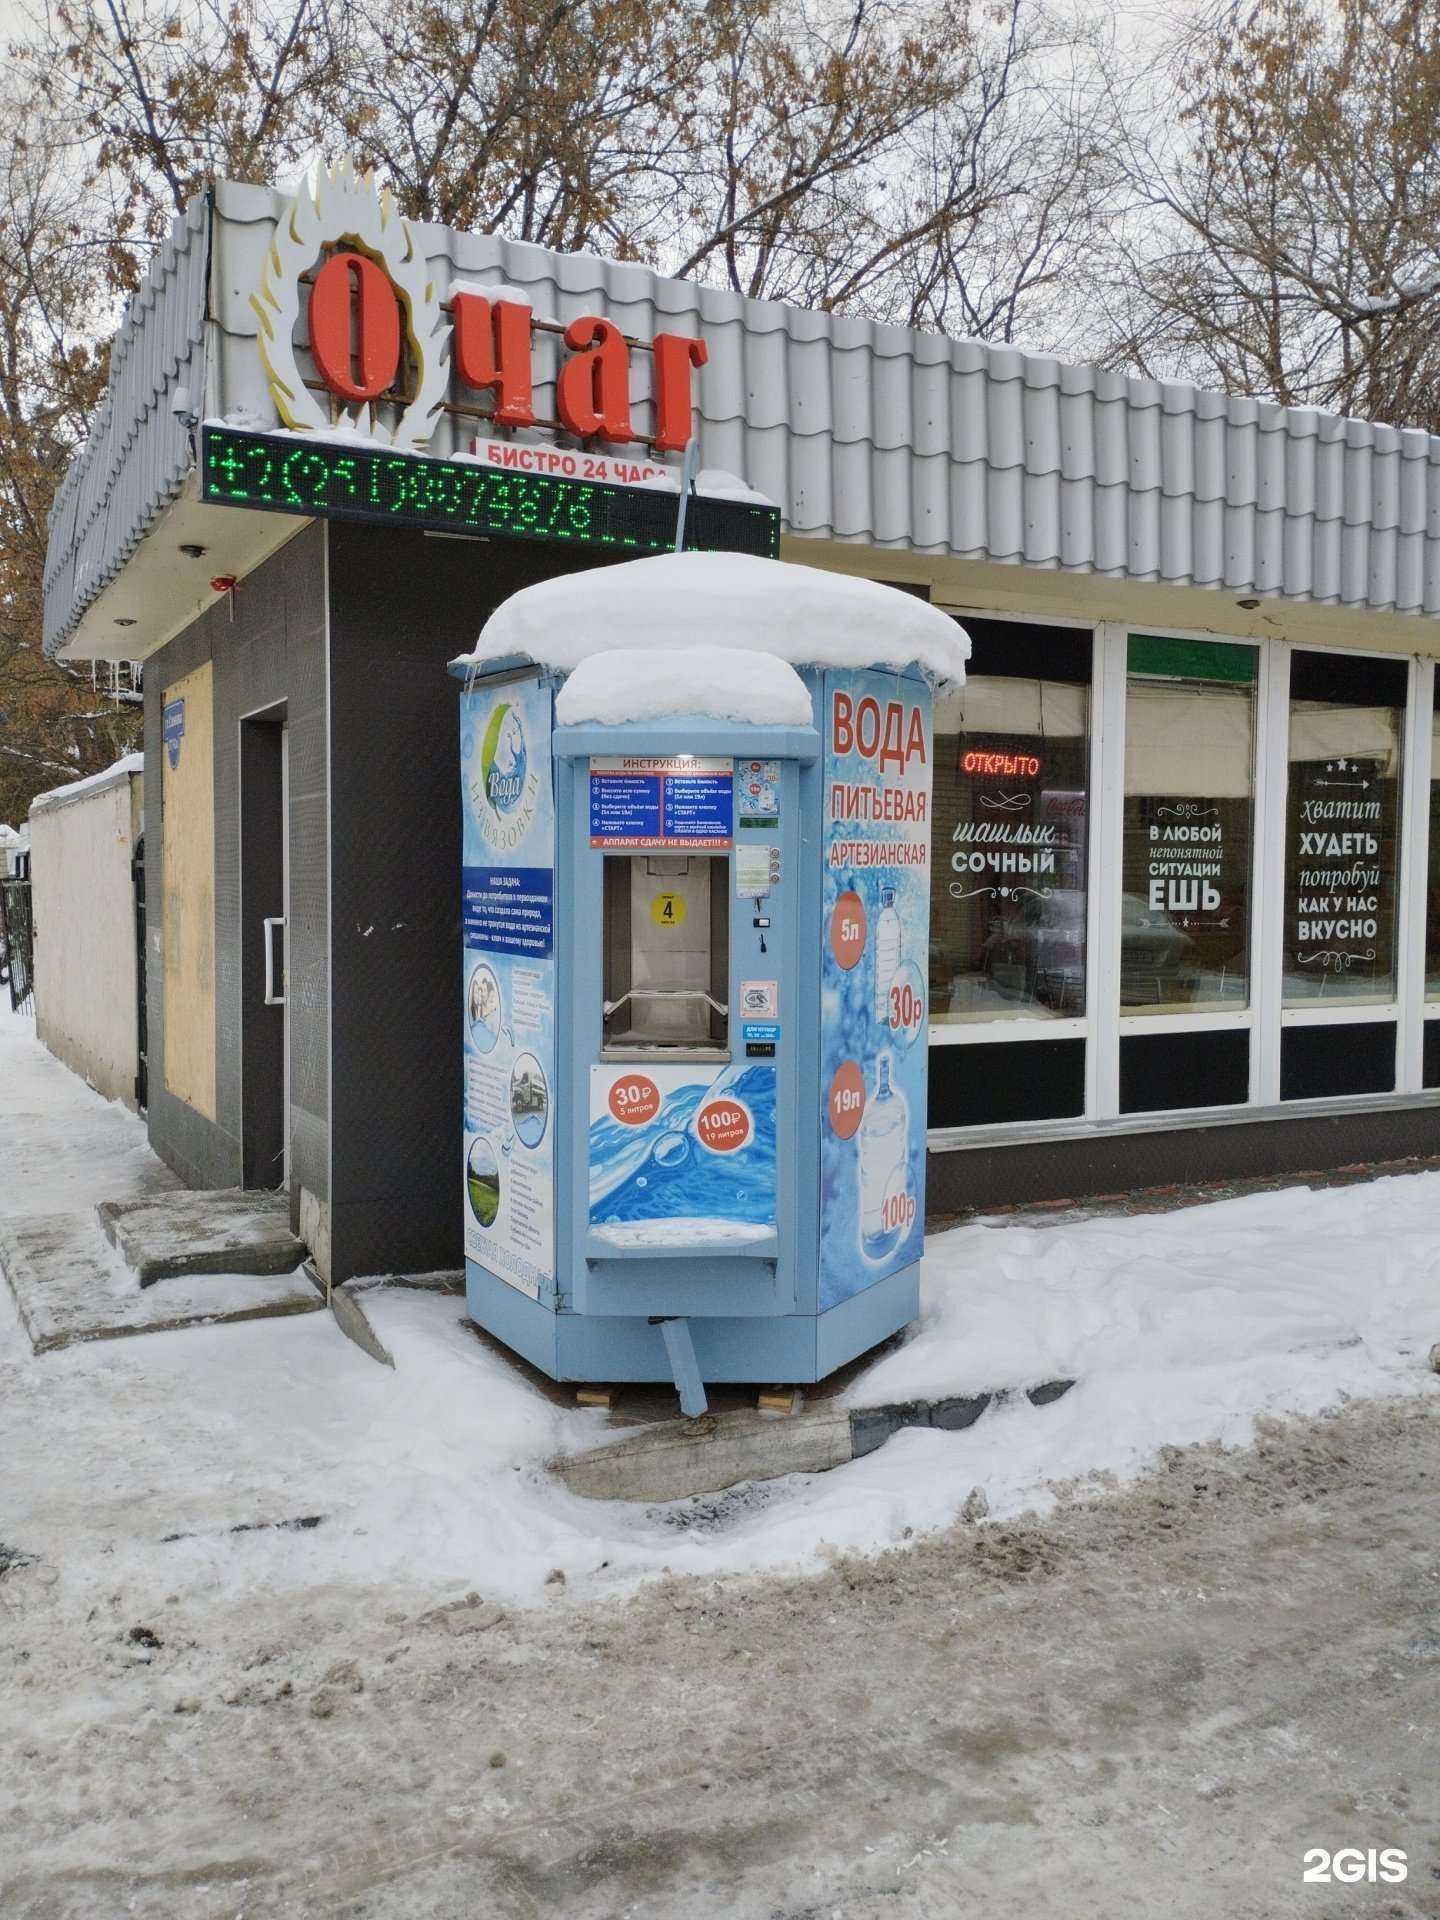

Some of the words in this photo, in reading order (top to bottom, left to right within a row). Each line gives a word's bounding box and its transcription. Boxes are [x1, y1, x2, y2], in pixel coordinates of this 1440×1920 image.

[308, 252, 707, 452] Очаг
[487, 444, 576, 476] БИСТРО
[583, 459, 607, 479] 24
[833, 691, 926, 775] ВОДА
[623, 759, 701, 769] ИНСТРУКЦИЯ:
[964, 752, 1039, 775] ОТКРЫТО
[488, 771, 520, 805] Вода
[831, 784, 927, 822] ПИТЬЕВАЯ
[1300, 799, 1381, 825] хватит
[602, 839, 639, 847] АППАРАТ
[640, 839, 666, 848] СДАЧУ
[952, 822, 1056, 844] шашлык
[1149, 825, 1159, 840] В
[1163, 823, 1222, 842] ЛЮБОЙ
[1299, 832, 1379, 857] ХУДЕТЬ
[830, 842, 927, 867] АРТЕЗИАНСКАЯ
[951, 848, 1055, 873] СОЧНЫЙ
[1149, 845, 1224, 860] непонятной
[1149, 862, 1221, 877] СИТУАЦИИ
[1299, 861, 1380, 894] попробуй
[1149, 879, 1221, 911] ЕШЬ
[1298, 897, 1330, 913] КАК
[1333, 896, 1343, 912] У
[1347, 896, 1378, 912] НАС
[663, 900, 673, 919] 4
[841, 918, 859, 942] 5л
[1298, 918, 1378, 941] ВКУСНО
[889, 983, 922, 1030] 30р
[620, 1107, 626, 1116] 5
[626, 1104, 653, 1115] литров
[834, 1088, 860, 1114] 19л
[706, 1133, 717, 1142] 19
[717, 1128, 744, 1140] литров
[882, 1191, 915, 1232] 100р
